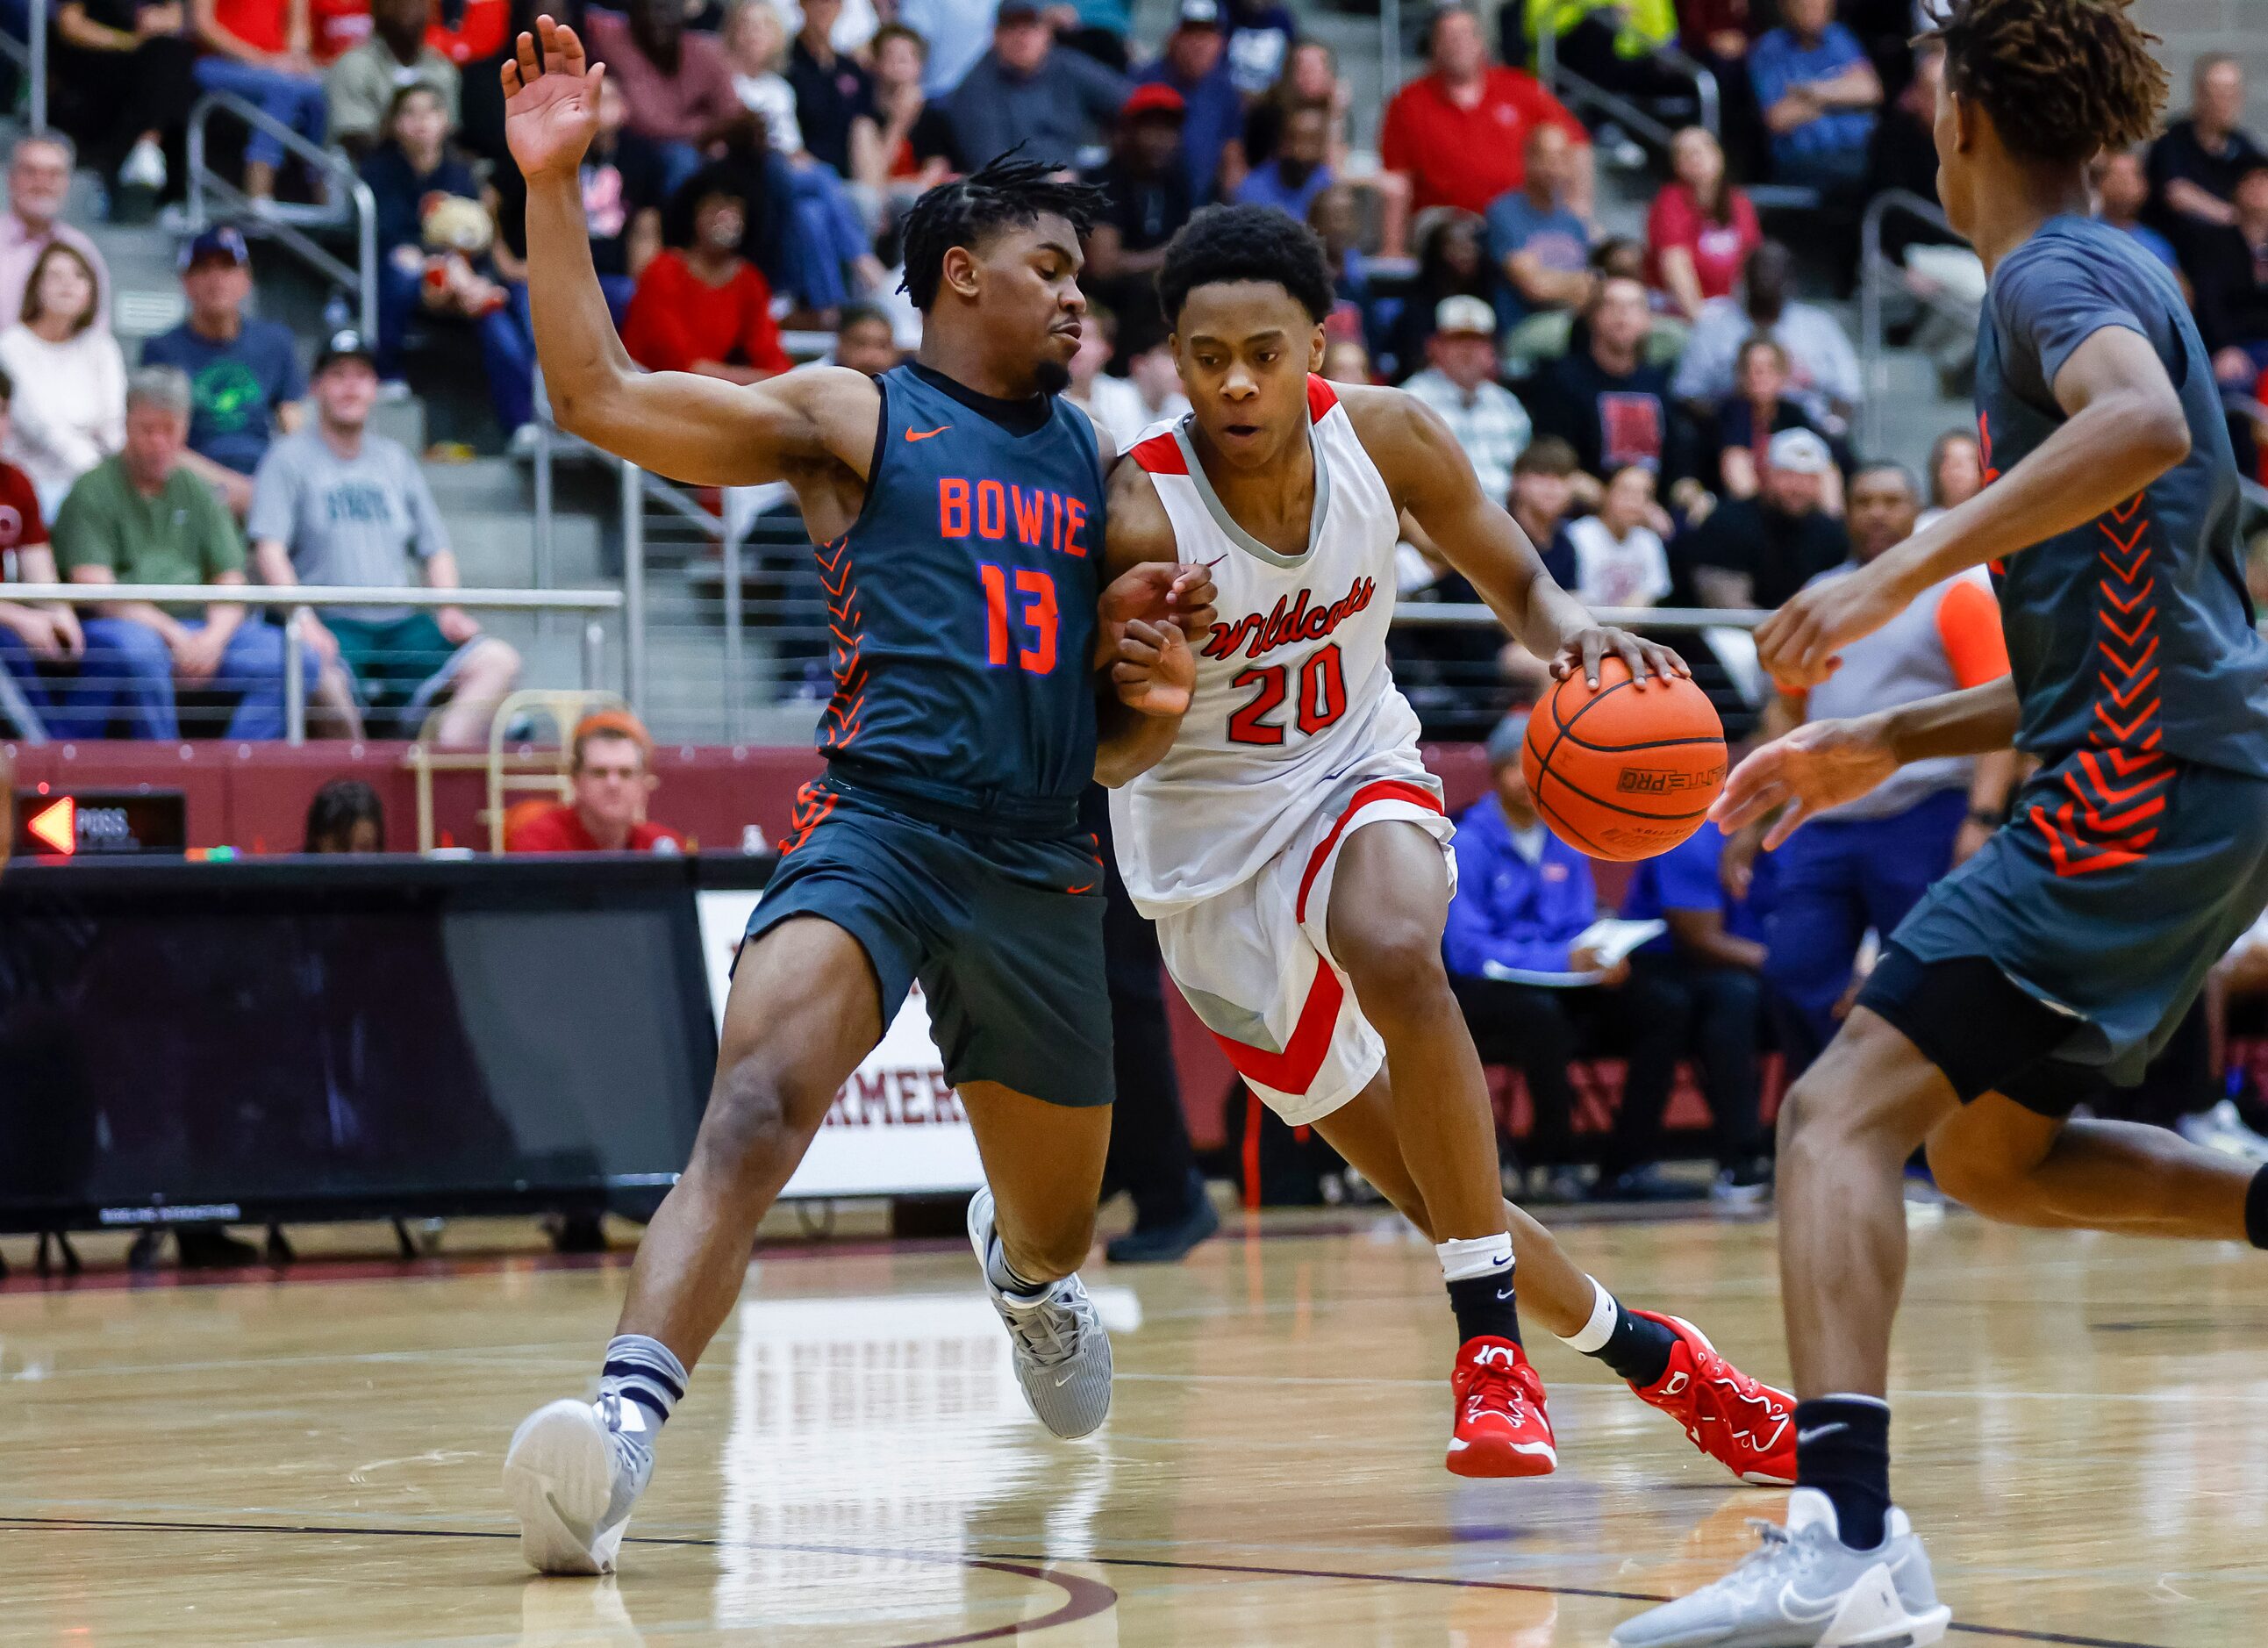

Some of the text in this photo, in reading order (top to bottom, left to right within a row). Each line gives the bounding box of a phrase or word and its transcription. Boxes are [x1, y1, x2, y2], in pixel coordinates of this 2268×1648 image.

[938, 477, 1088, 559] BOWIE
[978, 562, 1060, 675] 13
[1199, 576, 1377, 662] Wildcats
[1226, 639, 1349, 748] 20
